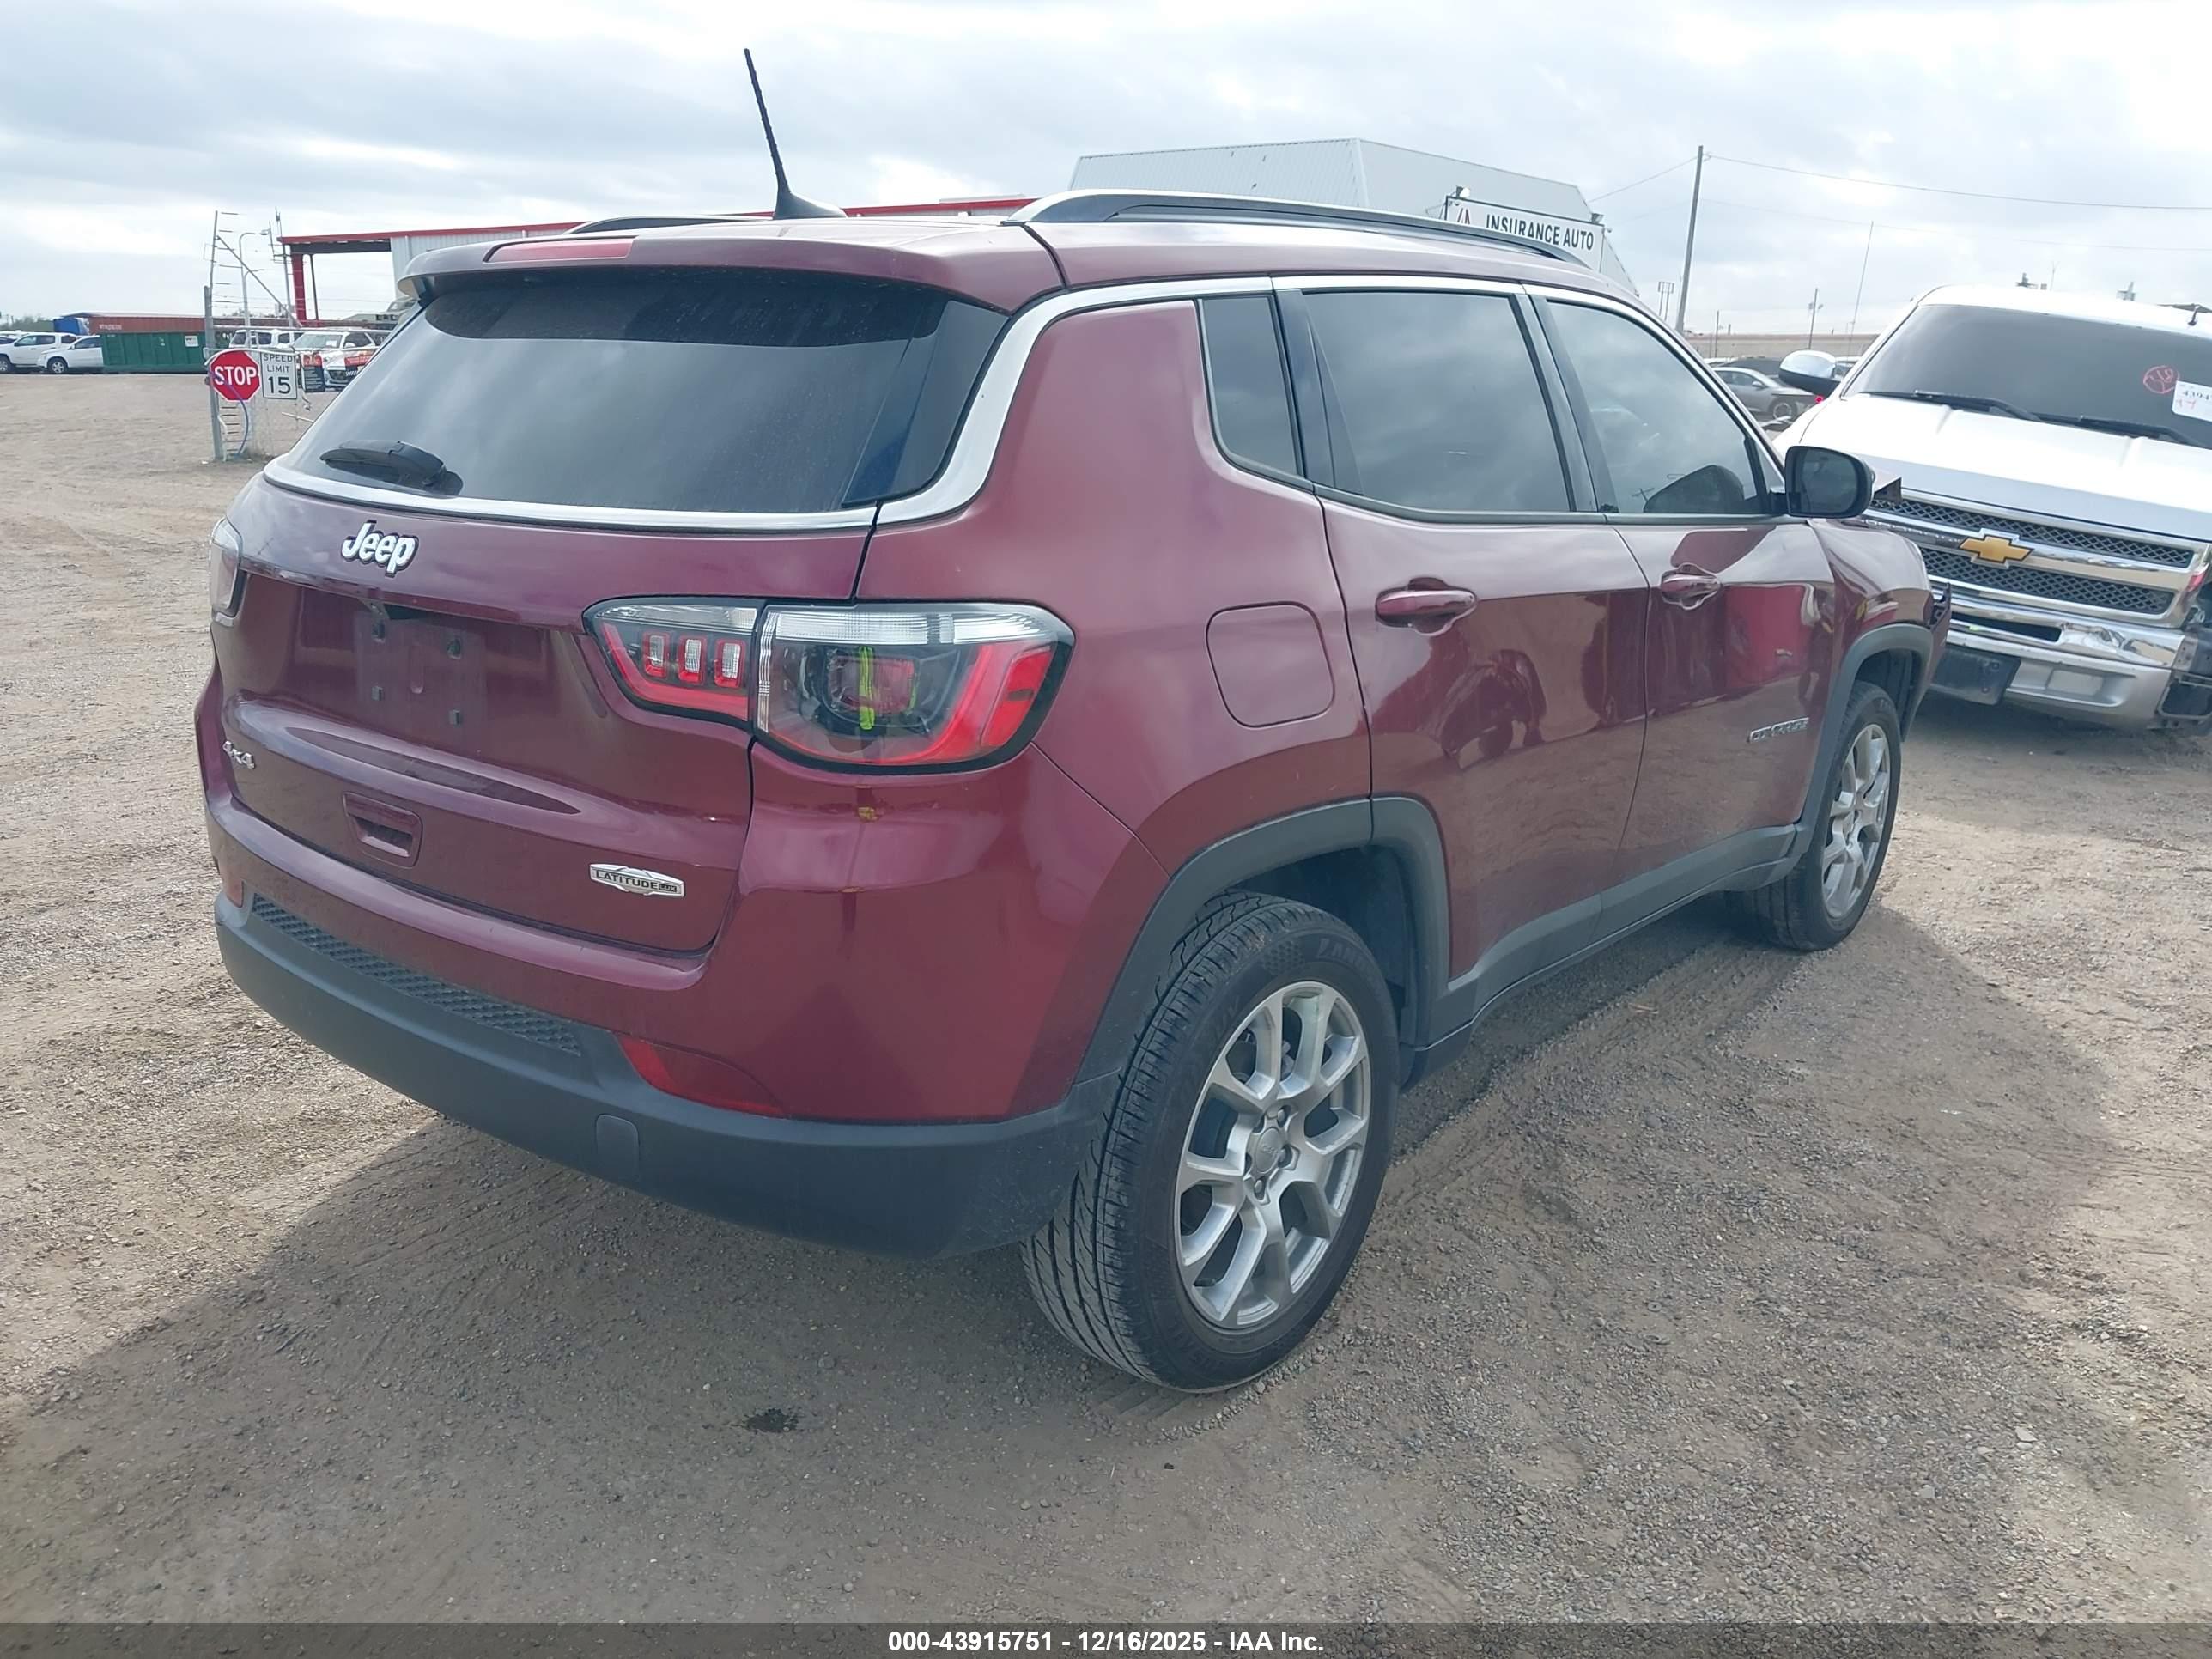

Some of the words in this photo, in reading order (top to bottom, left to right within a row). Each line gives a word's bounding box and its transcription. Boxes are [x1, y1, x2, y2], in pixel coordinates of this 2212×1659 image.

[1486, 214, 1560, 246] INSURANCE
[1563, 228, 1594, 251] AUTO
[263, 354, 293, 362] SPEED
[215, 365, 257, 386] STOP
[268, 377, 291, 394] 15
[341, 520, 418, 575] Jeep
[596, 869, 658, 890] LATITUDE
